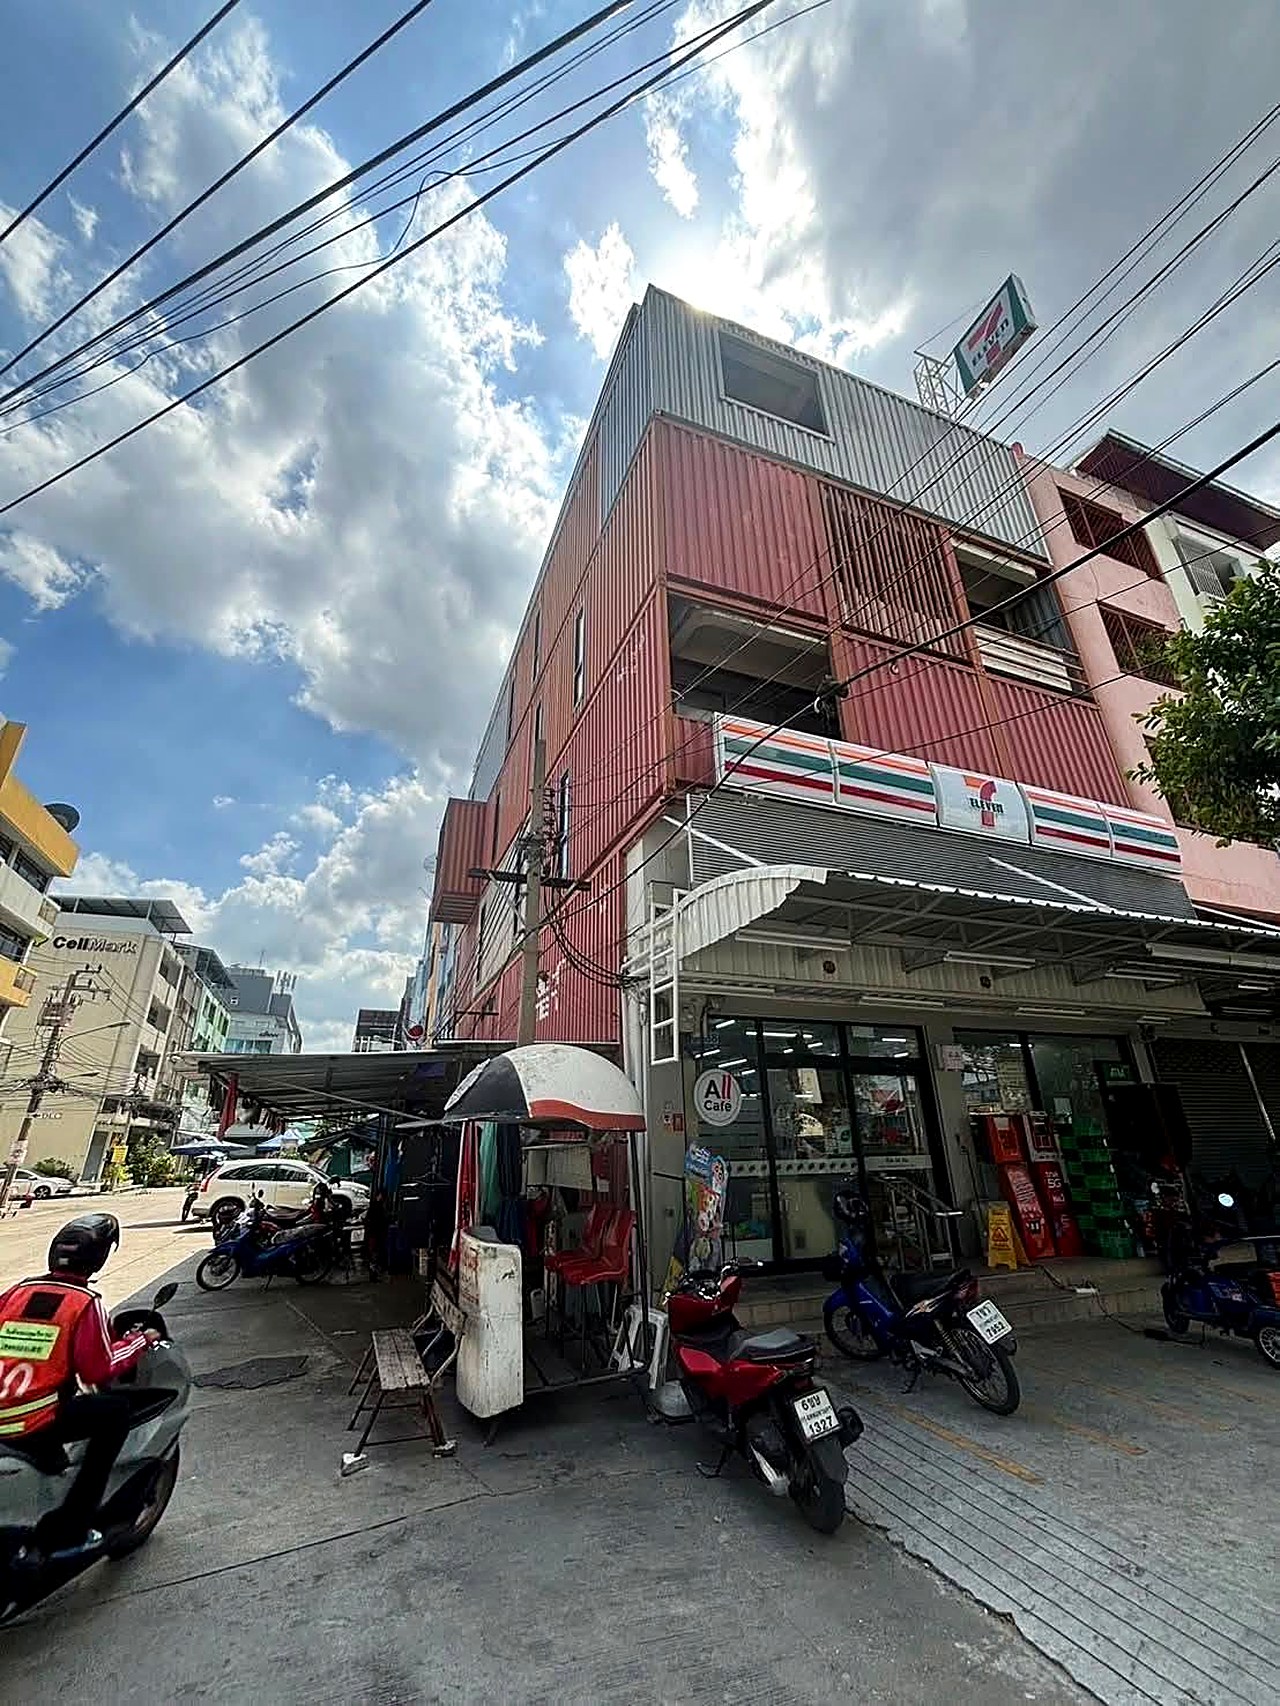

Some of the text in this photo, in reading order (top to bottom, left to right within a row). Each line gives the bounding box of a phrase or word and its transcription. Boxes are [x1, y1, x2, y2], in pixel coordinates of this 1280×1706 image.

[53, 936, 136, 954] CellMark
[705, 1074, 731, 1099] All
[704, 1100, 732, 1112] Café
[809, 1415, 833, 1435] 1327
